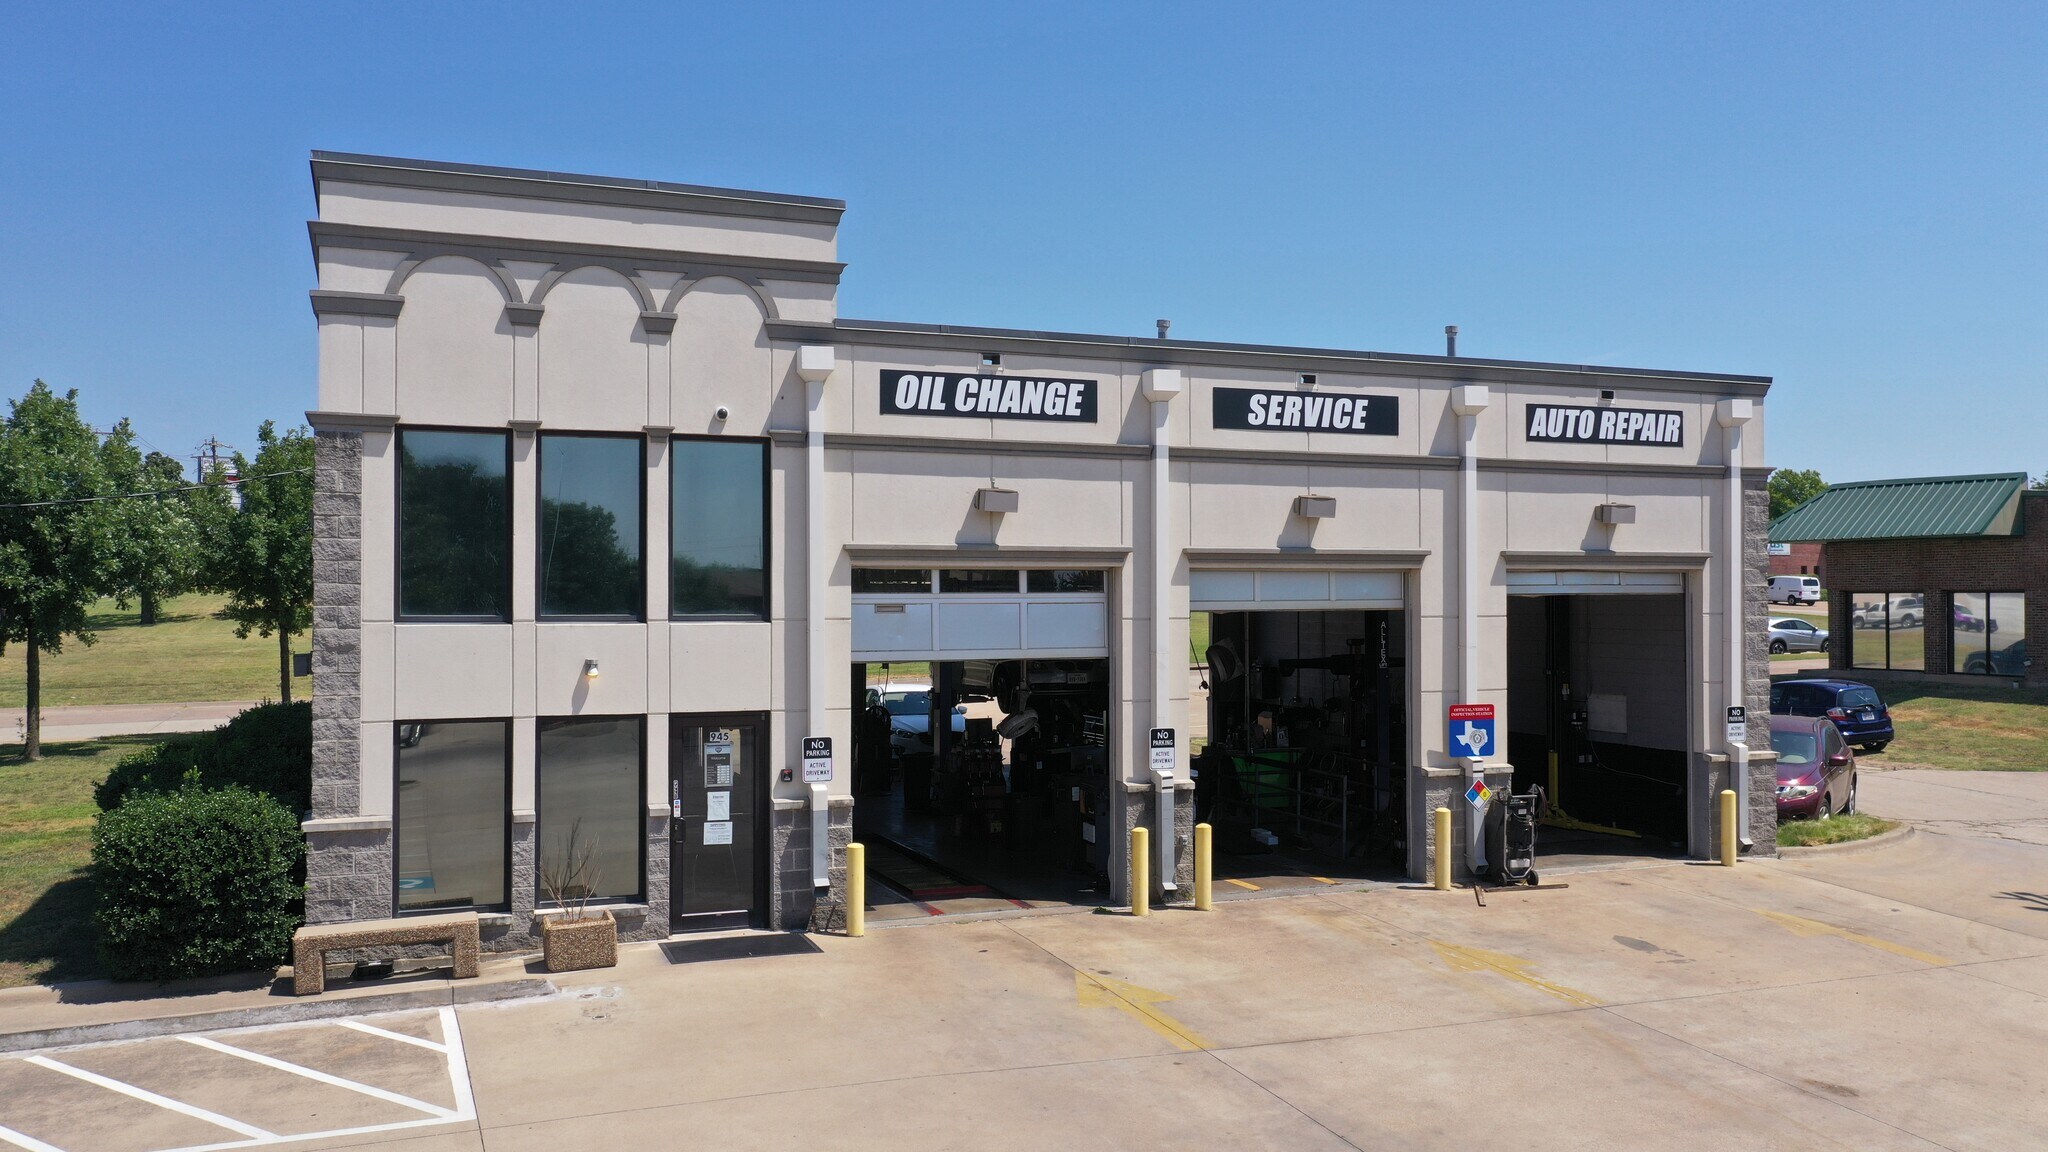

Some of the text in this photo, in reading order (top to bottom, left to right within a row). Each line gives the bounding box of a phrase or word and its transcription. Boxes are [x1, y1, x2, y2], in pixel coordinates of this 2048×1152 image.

[895, 374, 1085, 417] OIL CHANGE
[1247, 393, 1369, 430] SERVICE
[1529, 407, 1681, 443] AUTO REPAIR
[710, 732, 730, 741] 945
[811, 740, 825, 749] NO
[1157, 731, 1169, 740] NO
